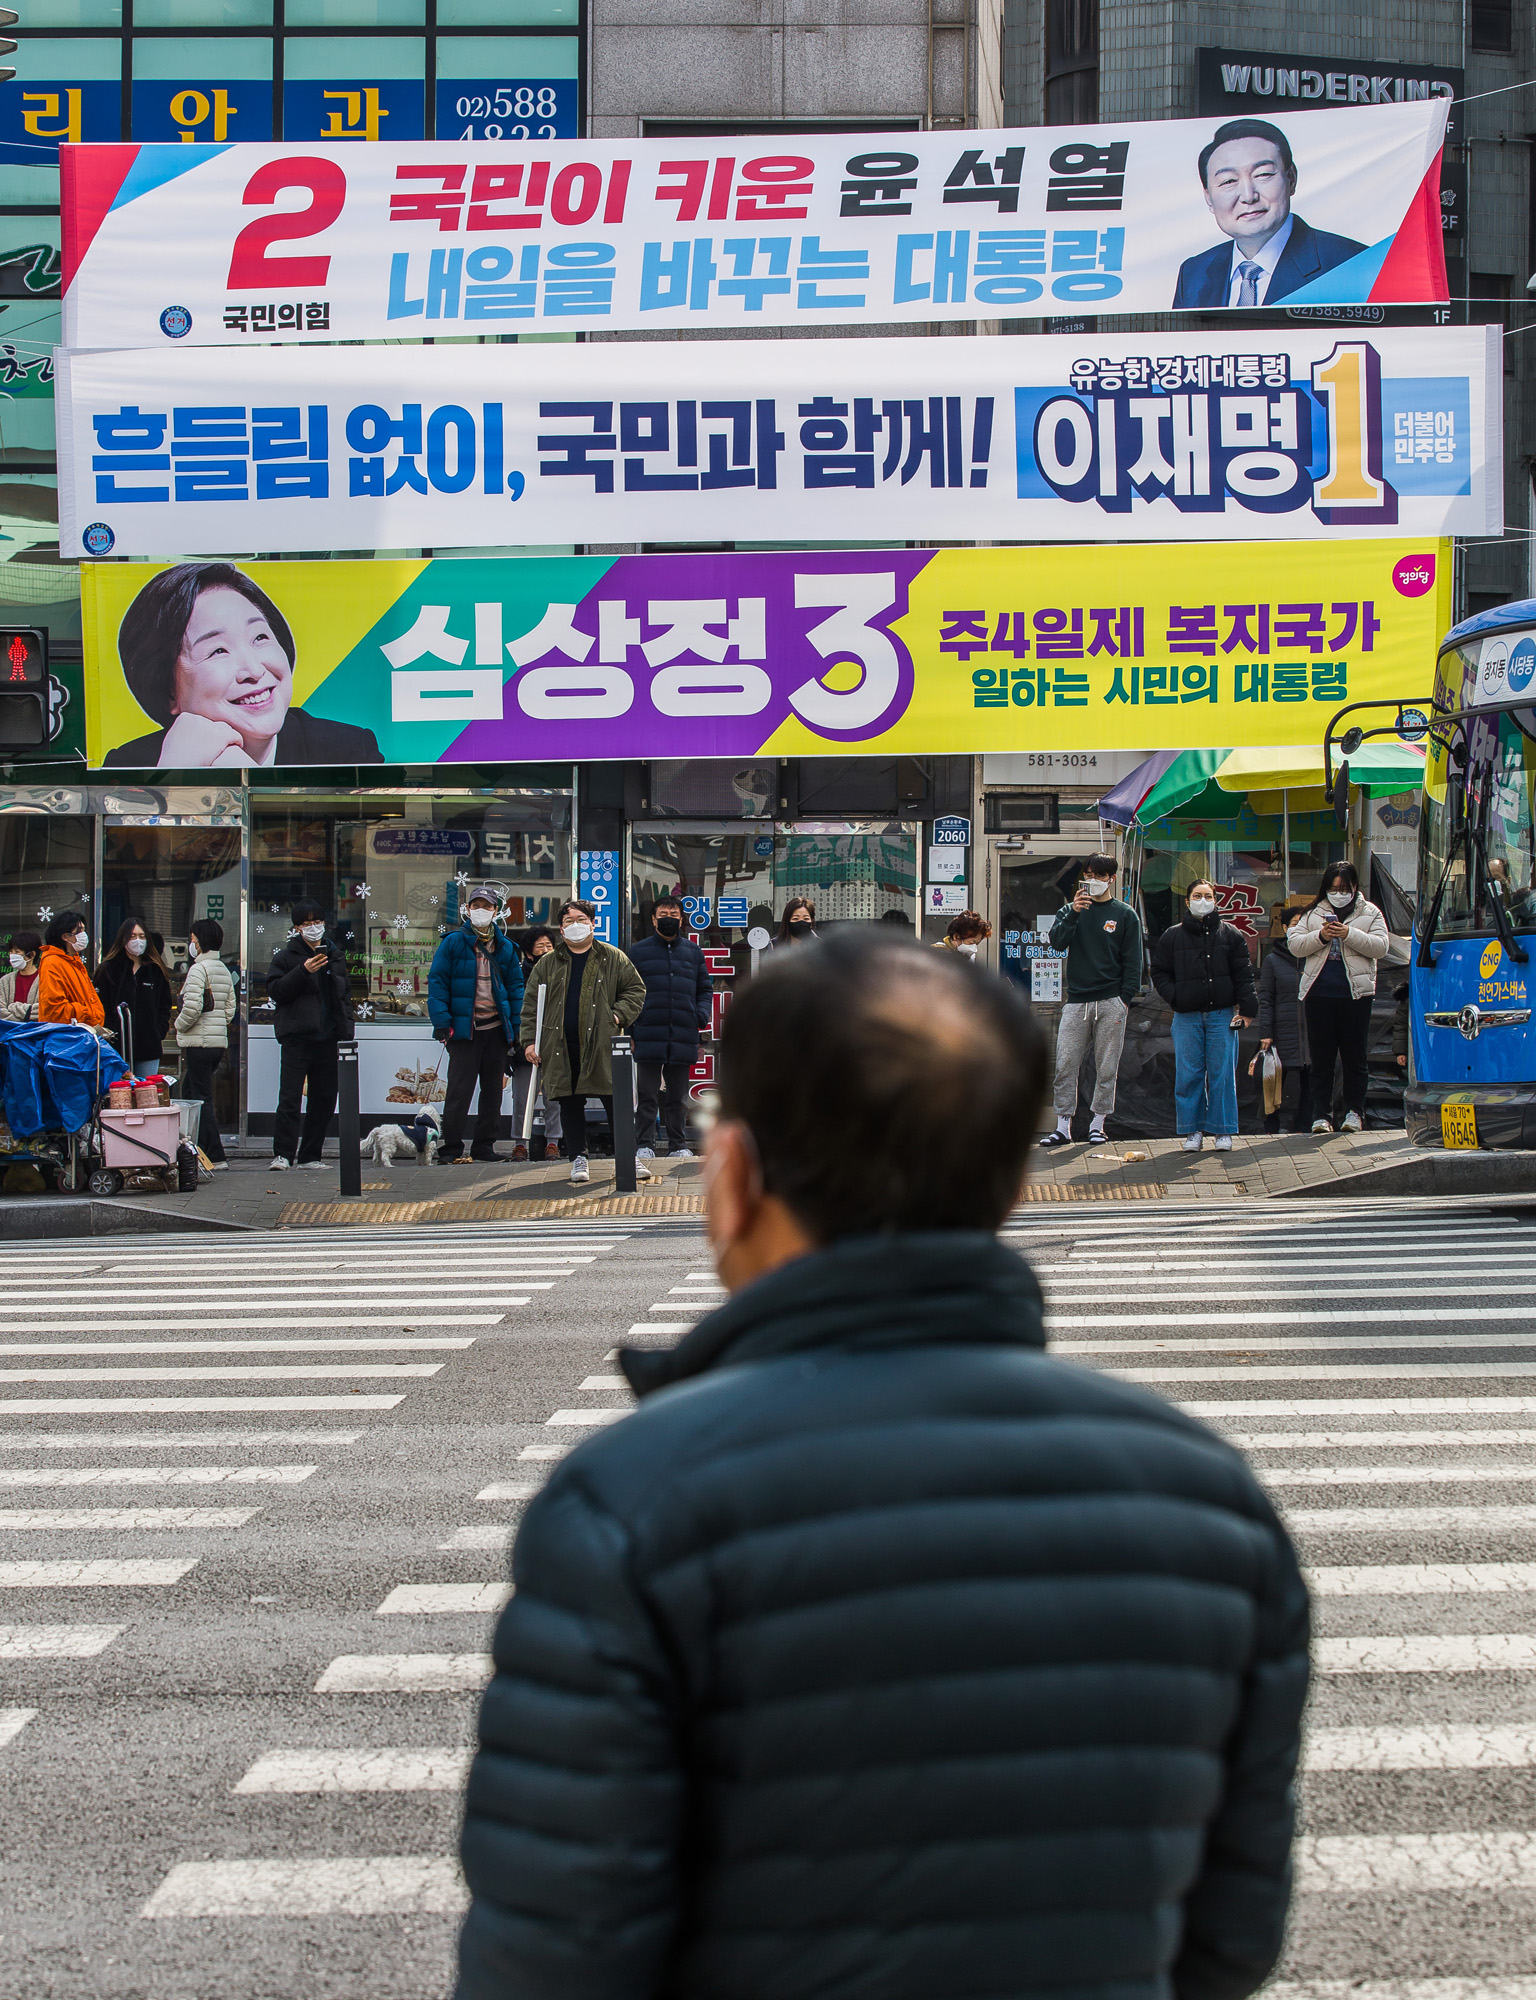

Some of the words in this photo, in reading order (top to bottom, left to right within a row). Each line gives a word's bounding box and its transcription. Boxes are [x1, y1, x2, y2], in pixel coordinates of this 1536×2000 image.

[1221, 63, 1455, 103] WUNDERKIND
[456, 87, 557, 119] 02)588
[389, 159, 633, 232] 국민이
[654, 155, 816, 222] 키운
[226, 155, 347, 290] 2
[386, 242, 617, 321] 내일을
[639, 236, 870, 313] 바꾸는
[893, 226, 1126, 305] 대통령
[222, 301, 330, 333] 국민의힘
[1433, 309, 1451, 325] 1F
[1070, 358, 1150, 391] 유능한
[1154, 354, 1287, 389] 경제대통령
[1314, 343, 1386, 509] 1
[1393, 410, 1456, 438] 더불어
[91, 404, 329, 504] 흔들림
[345, 402, 526, 502] 없이,
[536, 398, 786, 494] 국민과
[797, 396, 996, 489] 함께!
[1036, 391, 1299, 498] 이재명
[1393, 438, 1457, 464] 민주당
[1398, 566, 1431, 586] 정의당
[938, 605, 1145, 662] 주4일제
[1166, 600, 1382, 657] 복지국가
[378, 596, 773, 723] 심상정
[787, 571, 900, 731] 3
[1508, 655, 1535, 677] 사당동
[971, 666, 1091, 709] 일하는
[1104, 664, 1212, 706] 시민의
[1233, 660, 1350, 704] 대통령
[1483, 658, 1507, 681] 장지동
[1028, 754, 1098, 767] 581-3034
[1384, 810, 1418, 825] 어사품
[756, 842, 772, 850] ADT
[937, 830, 966, 843] 2060
[680, 895, 750, 931] 앵콜
[1213, 883, 1264, 938] 꽃
[1005, 930, 1020, 943] HP
[1005, 945, 1020, 958] Tel
[1481, 952, 1499, 967] CNG
[1478, 980, 1527, 1003] 천연가스버스
